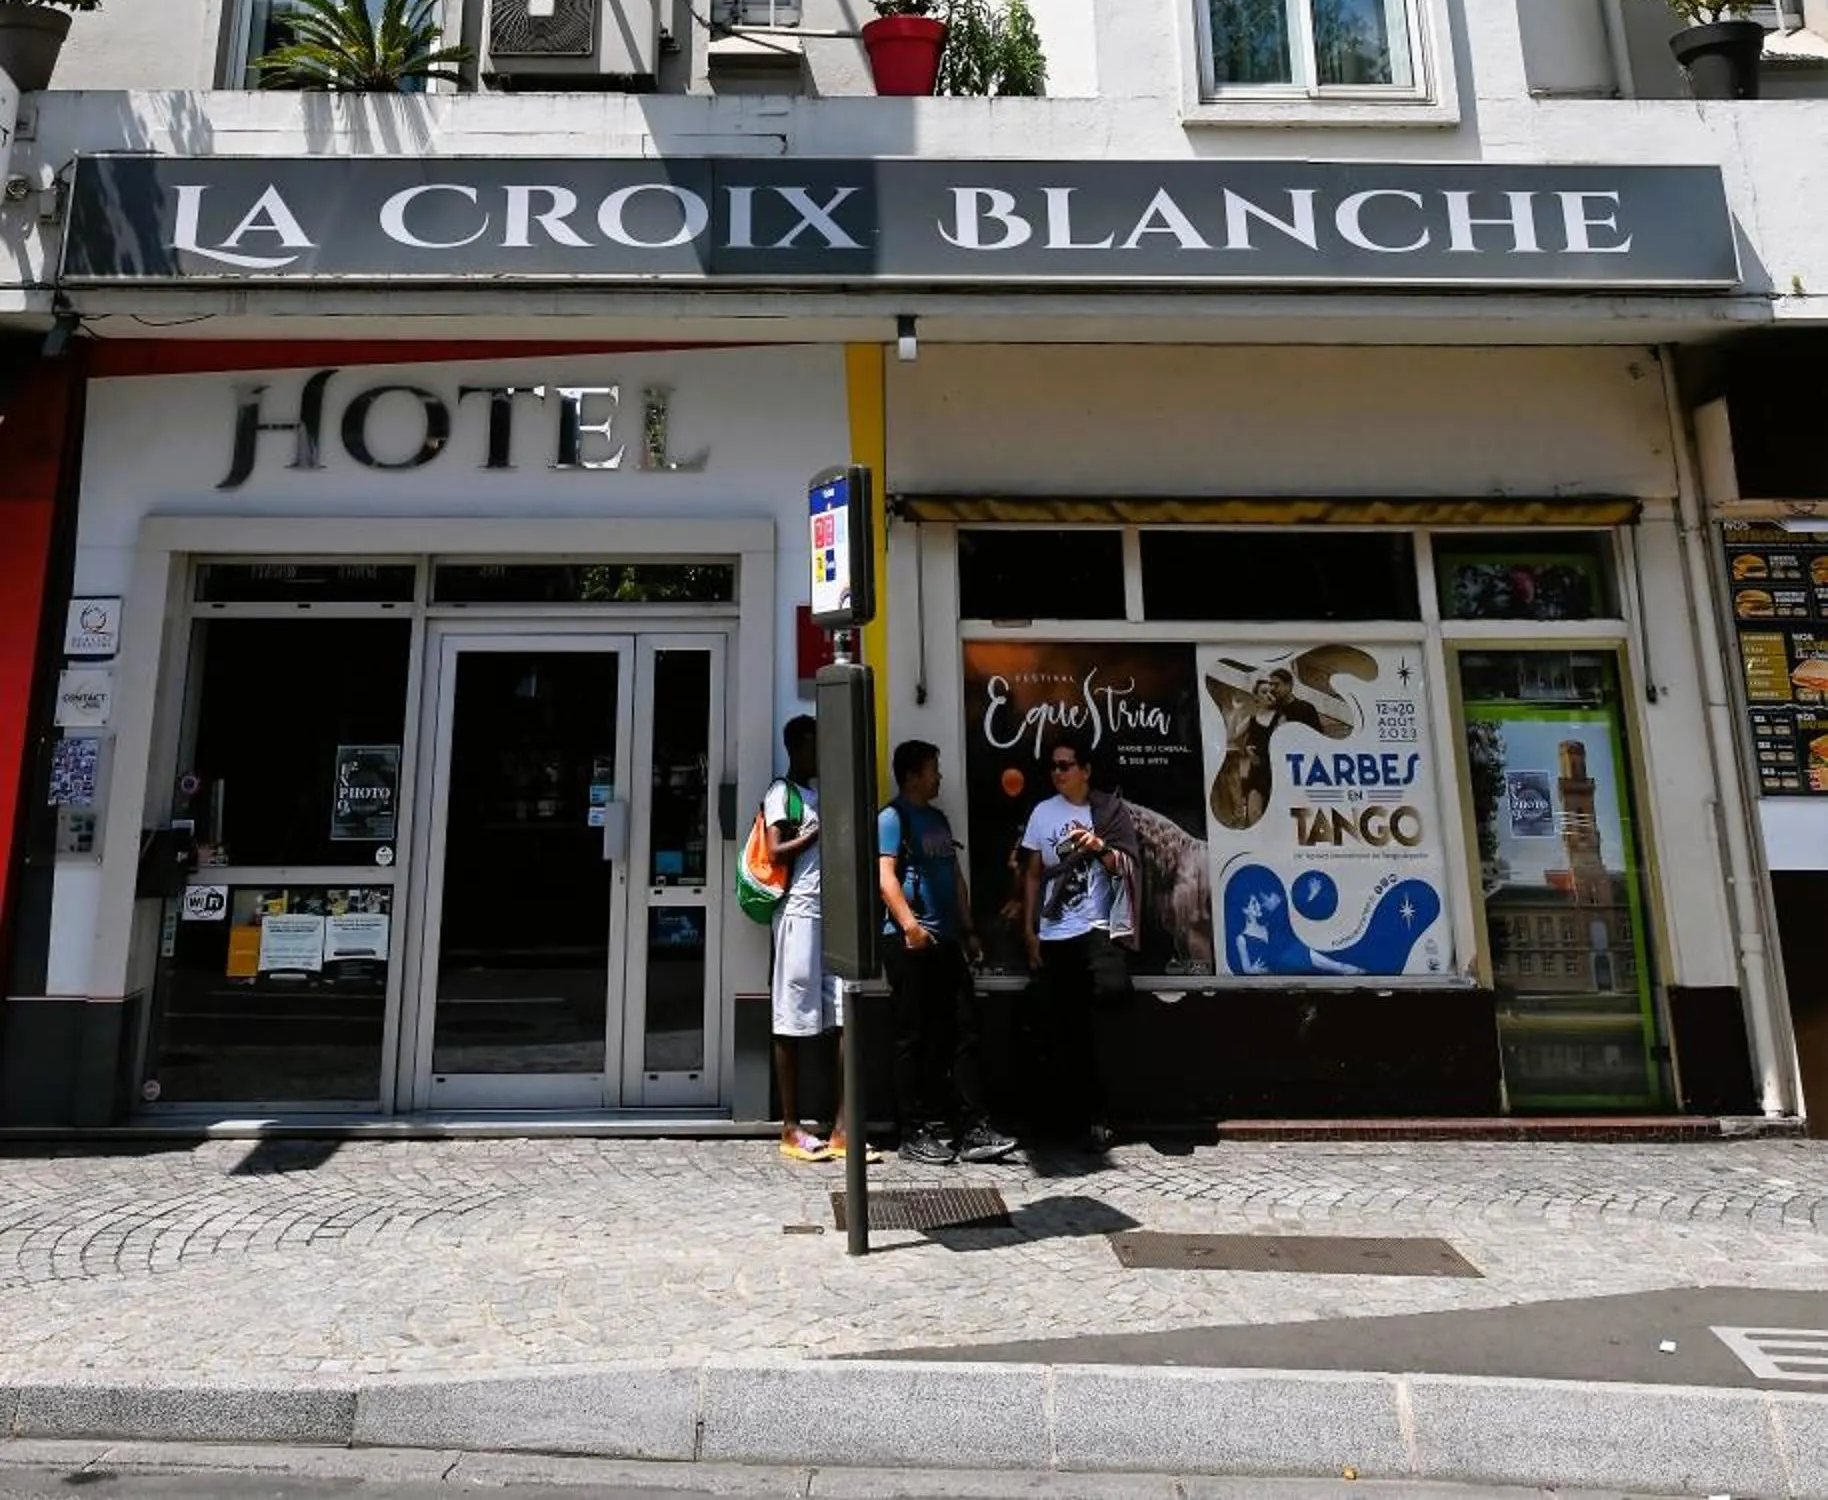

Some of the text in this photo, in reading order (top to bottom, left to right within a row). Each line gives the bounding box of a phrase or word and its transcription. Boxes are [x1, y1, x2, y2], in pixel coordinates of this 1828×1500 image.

[171, 184, 1633, 269] LA CROIX BLANCHE
[215, 368, 711, 490] HOTEL
[1285, 753, 1420, 787] TARBES
[1347, 789, 1363, 801] EN
[1289, 805, 1424, 847] TANGO
